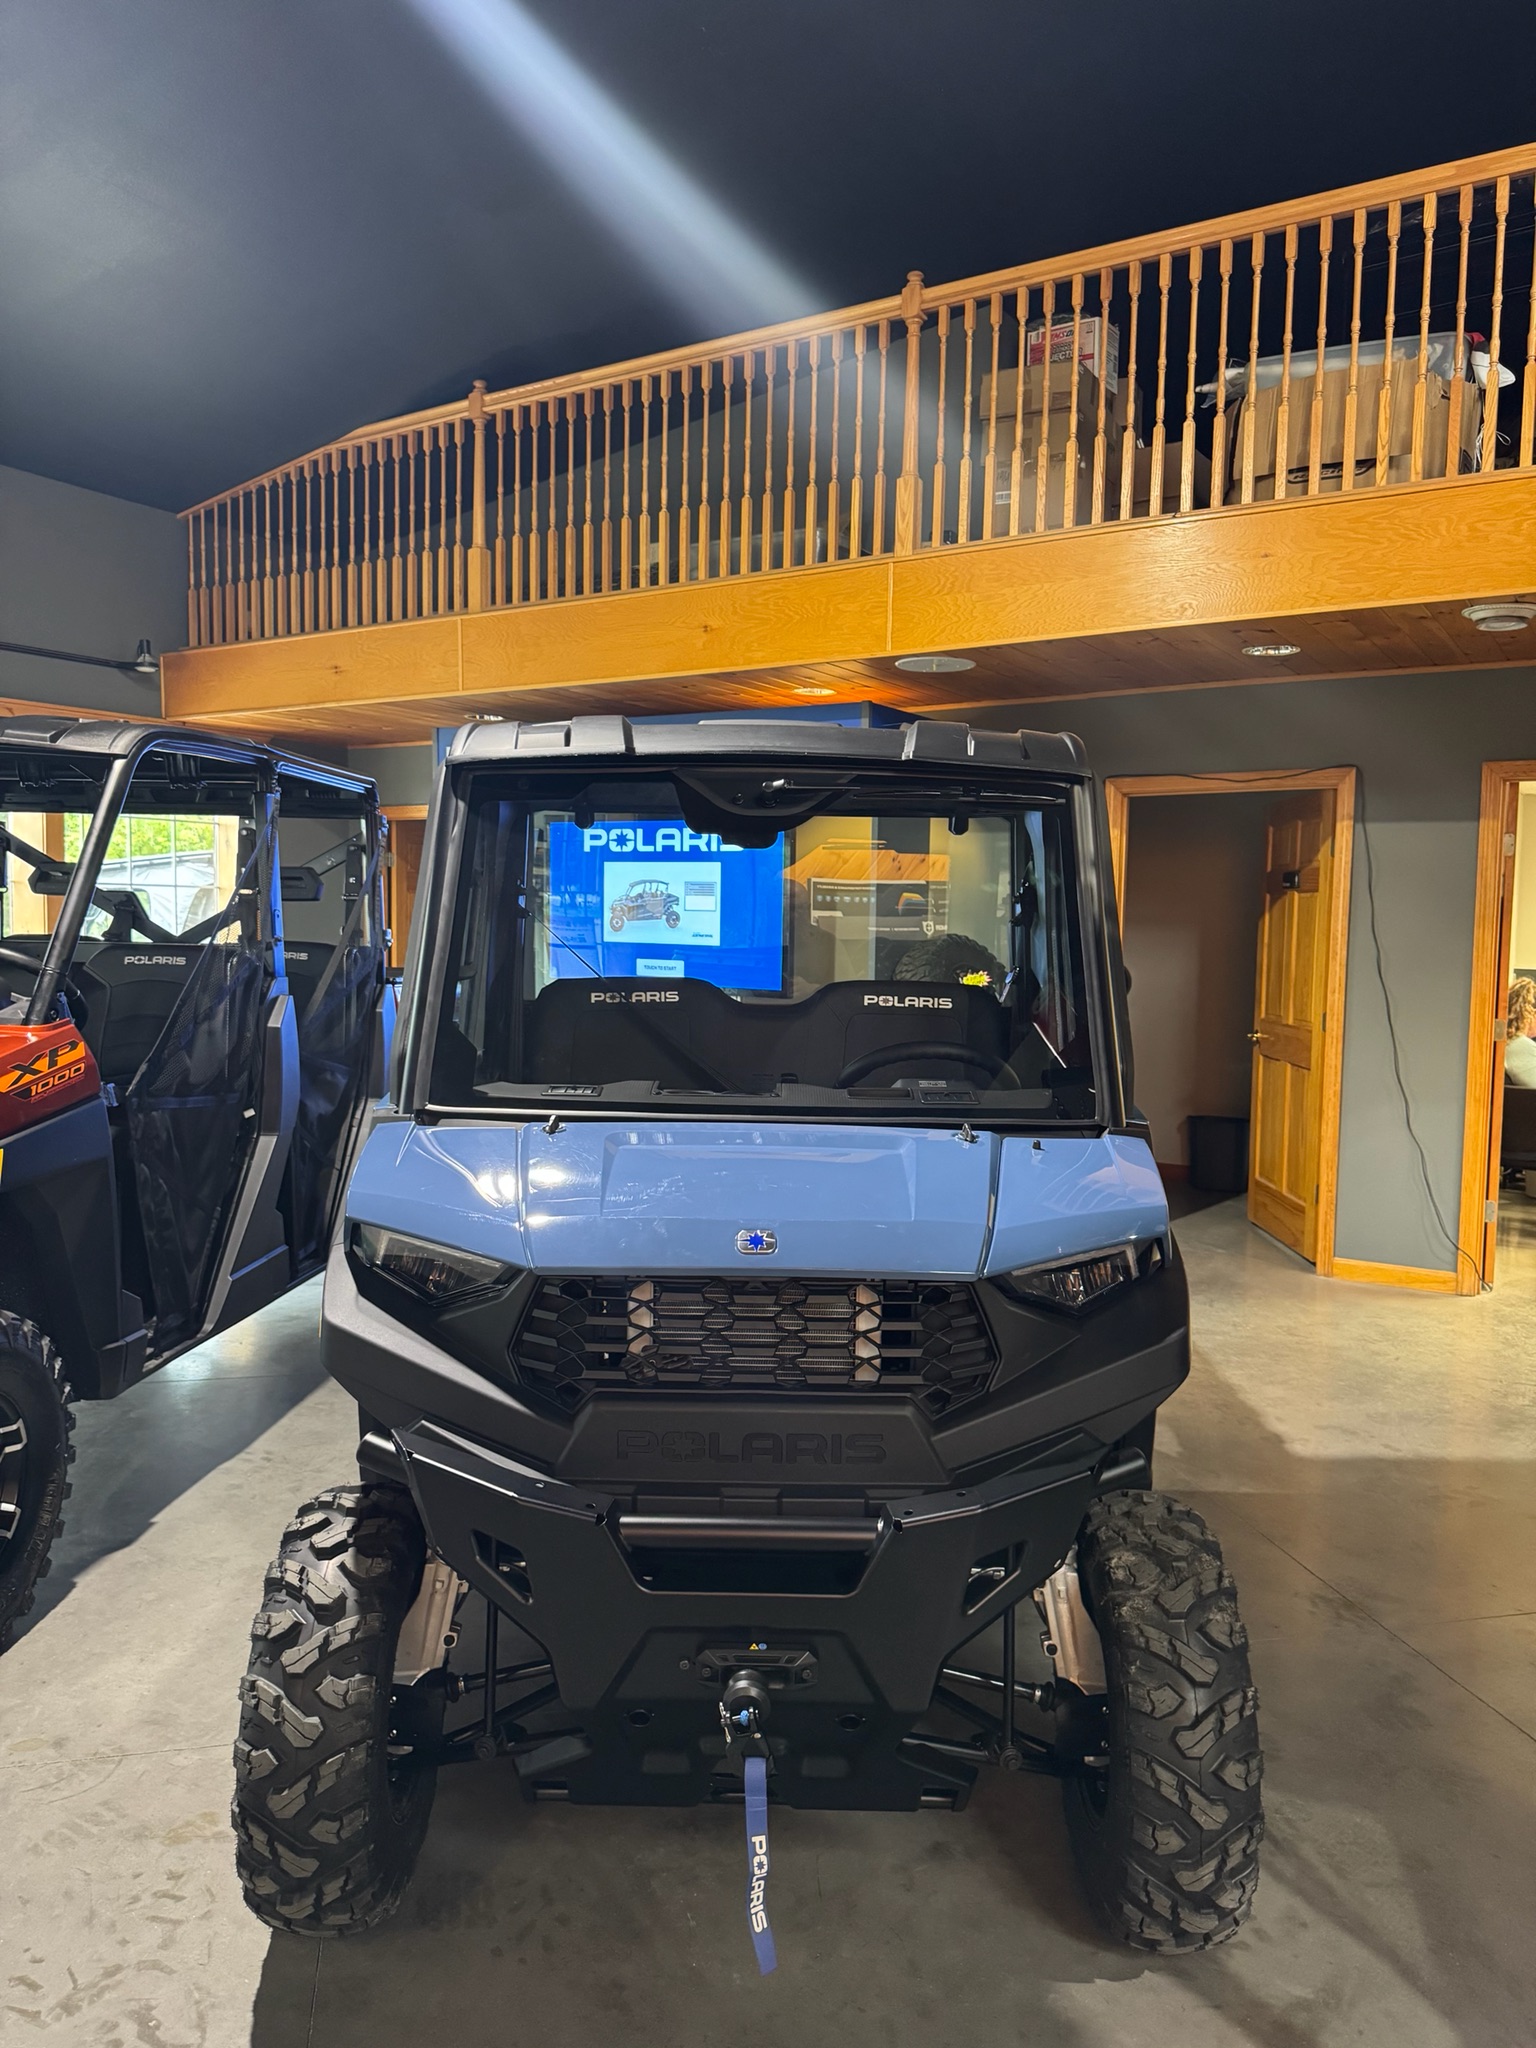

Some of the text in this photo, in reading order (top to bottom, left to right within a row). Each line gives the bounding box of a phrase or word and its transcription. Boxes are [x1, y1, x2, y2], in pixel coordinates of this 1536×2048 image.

[583, 828, 744, 852] POLARI
[124, 955, 187, 966] POLARIS
[283, 951, 308, 960] ARIS
[863, 994, 953, 1010] POLARIS
[7, 1038, 80, 1090] XP
[30, 1062, 85, 1097] 1000
[616, 1429, 887, 1465] POLARIS
[751, 1834, 769, 1934] POLARIS
